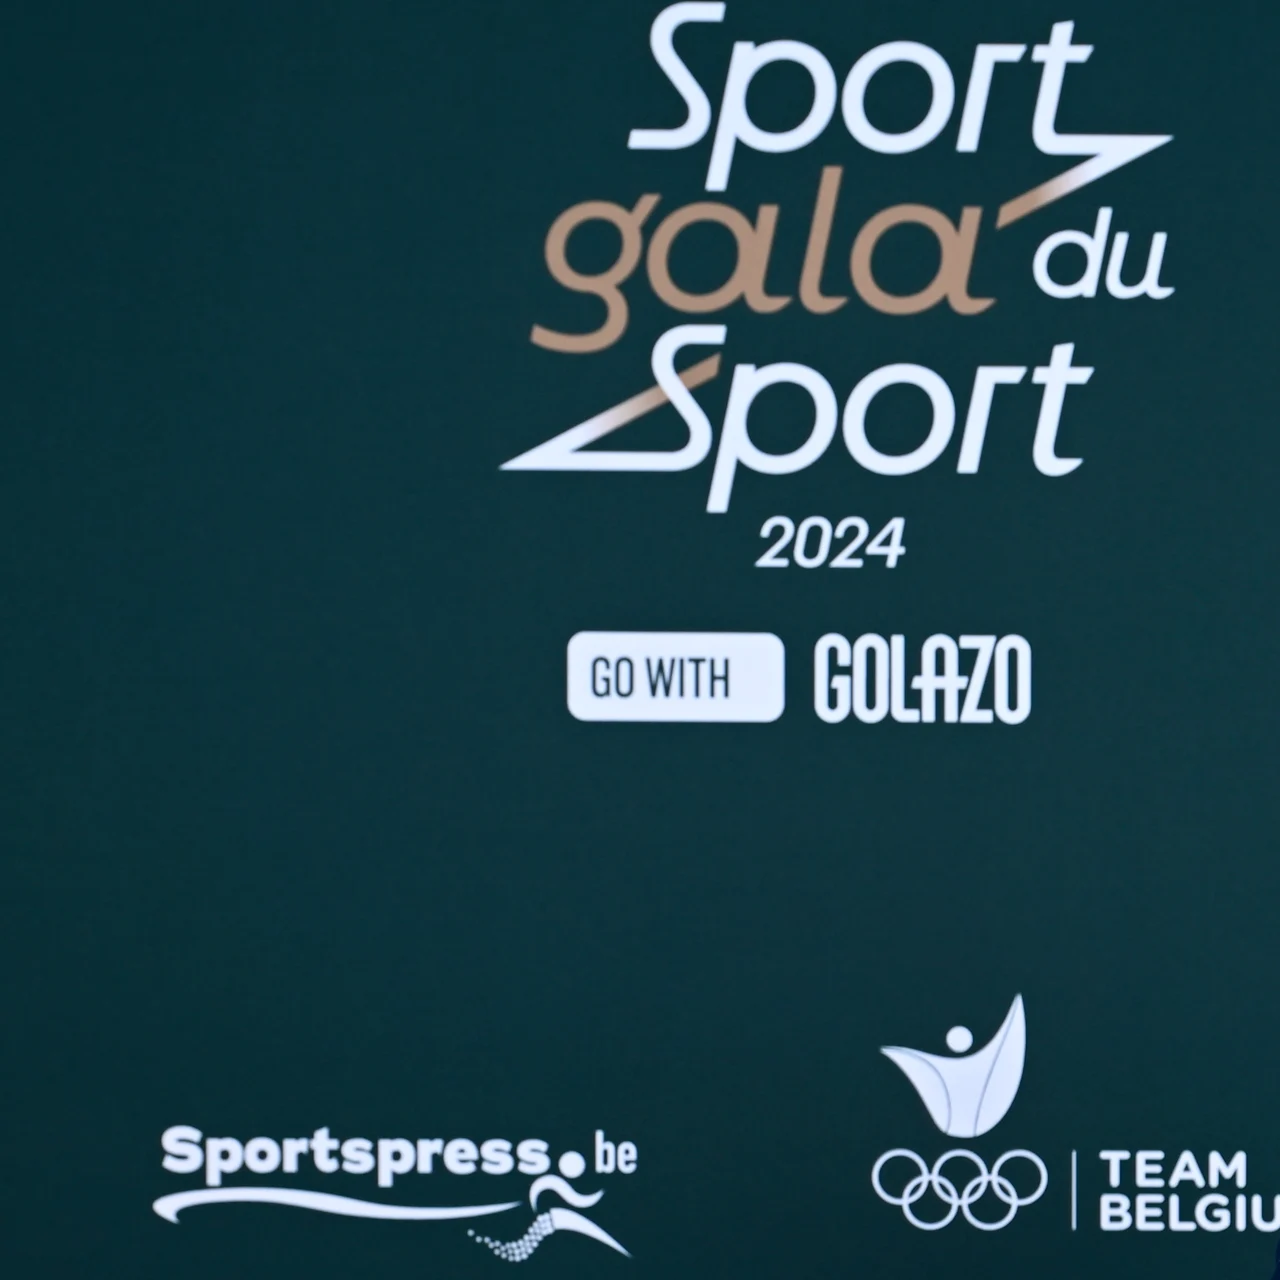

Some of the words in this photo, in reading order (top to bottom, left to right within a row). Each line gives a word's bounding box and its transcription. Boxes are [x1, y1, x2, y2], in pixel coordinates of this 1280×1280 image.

[627, 0, 1174, 192] Sport
[530, 165, 996, 354] gala
[1032, 206, 1174, 299] du
[499, 324, 1095, 513] Sport
[755, 516, 905, 568] 2024
[591, 656, 634, 698] GO
[646, 658, 729, 698] WITH
[814, 633, 1031, 724] GOLAZO
[1099, 1150, 1246, 1188] TEAM
